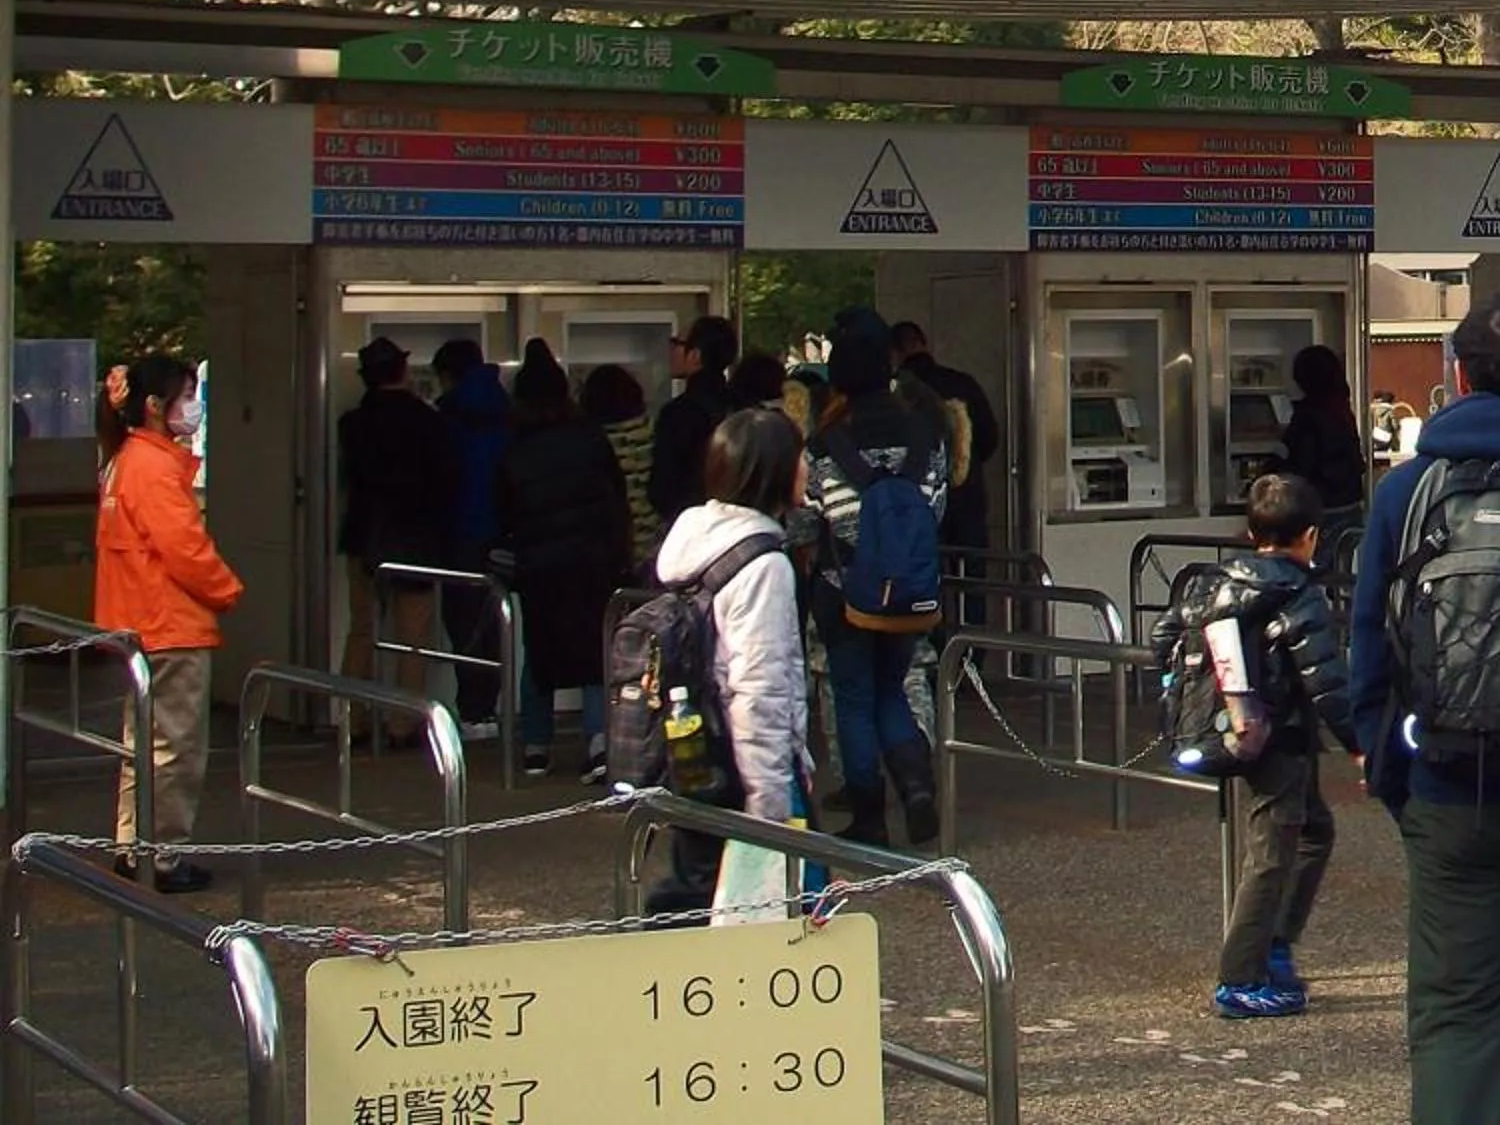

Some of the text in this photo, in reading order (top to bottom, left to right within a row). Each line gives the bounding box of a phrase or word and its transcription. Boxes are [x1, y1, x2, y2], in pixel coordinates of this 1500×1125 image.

[446, 26, 675, 69] チケット販売機
[1146, 60, 1330, 96] チケット販売機
[79, 169, 148, 194] 入場口
[60, 197, 166, 219] ENTRANCE
[519, 196, 587, 215] Children
[861, 188, 917, 209] 入場口
[849, 214, 931, 233] ENTRANCE
[354, 963, 845, 1053] 入園終了 16:00
[644, 1046, 847, 1108] 16:30
